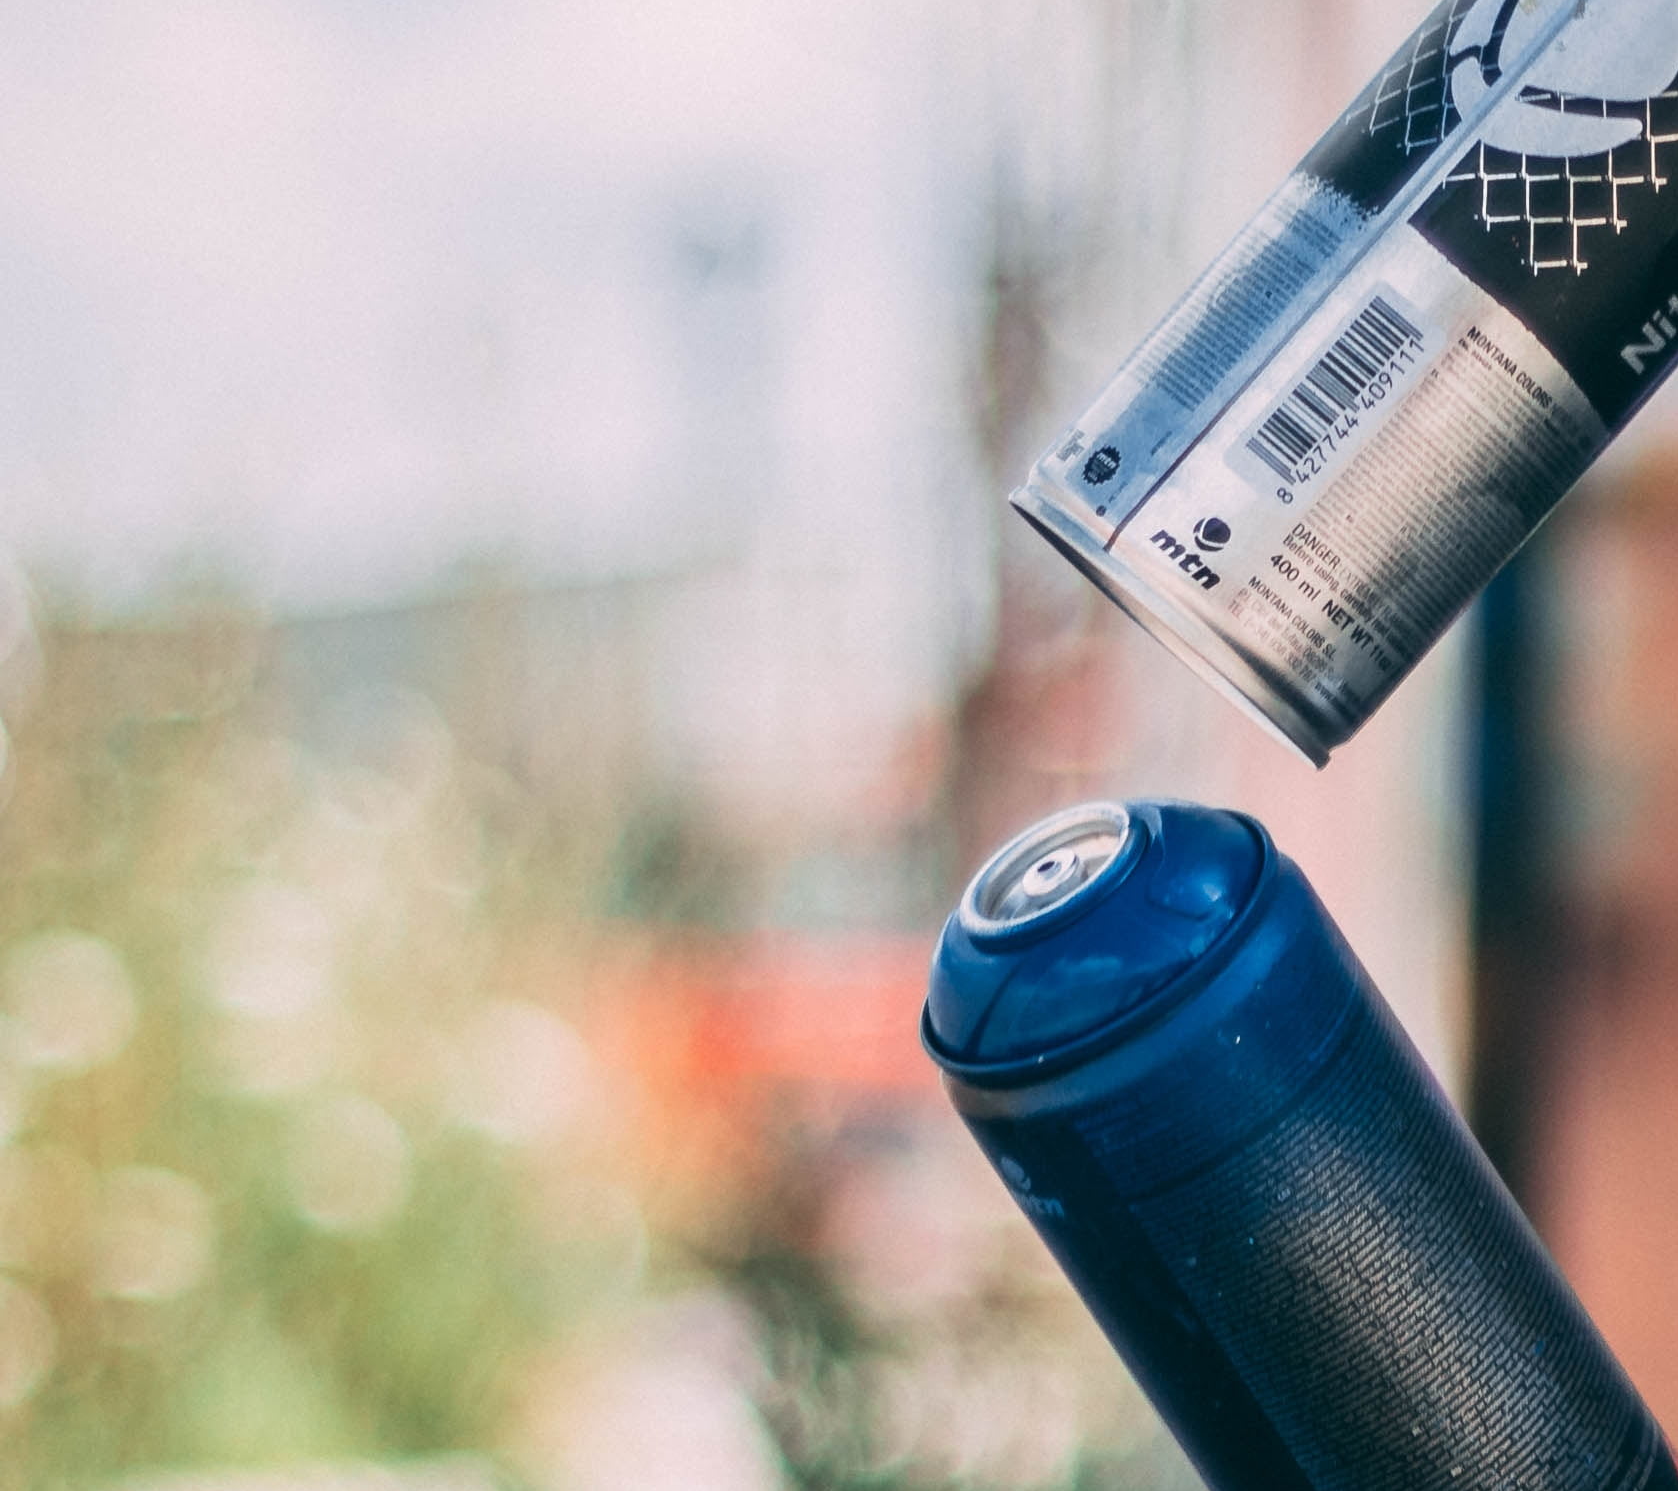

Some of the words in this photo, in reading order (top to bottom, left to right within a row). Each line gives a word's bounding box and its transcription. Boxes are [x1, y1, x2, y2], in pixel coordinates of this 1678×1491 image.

[1466, 326, 1518, 376] MONTANA
[1514, 370, 1554, 408] COLORS
[1275, 485, 1295, 505] 8
[1292, 411, 1361, 485] 427744
[1357, 337, 1426, 411] 409111
[1096, 452, 1116, 468] mtn
[1149, 526, 1221, 592] mtn
[1282, 534, 1315, 567] Before
[1247, 576, 1294, 621] MONTANA
[1290, 615, 1325, 650] COLORS
[1268, 551, 1300, 583] 400
[1297, 578, 1320, 602] ml
[1320, 598, 1355, 632] NET
[1348, 624, 1374, 653] WT
